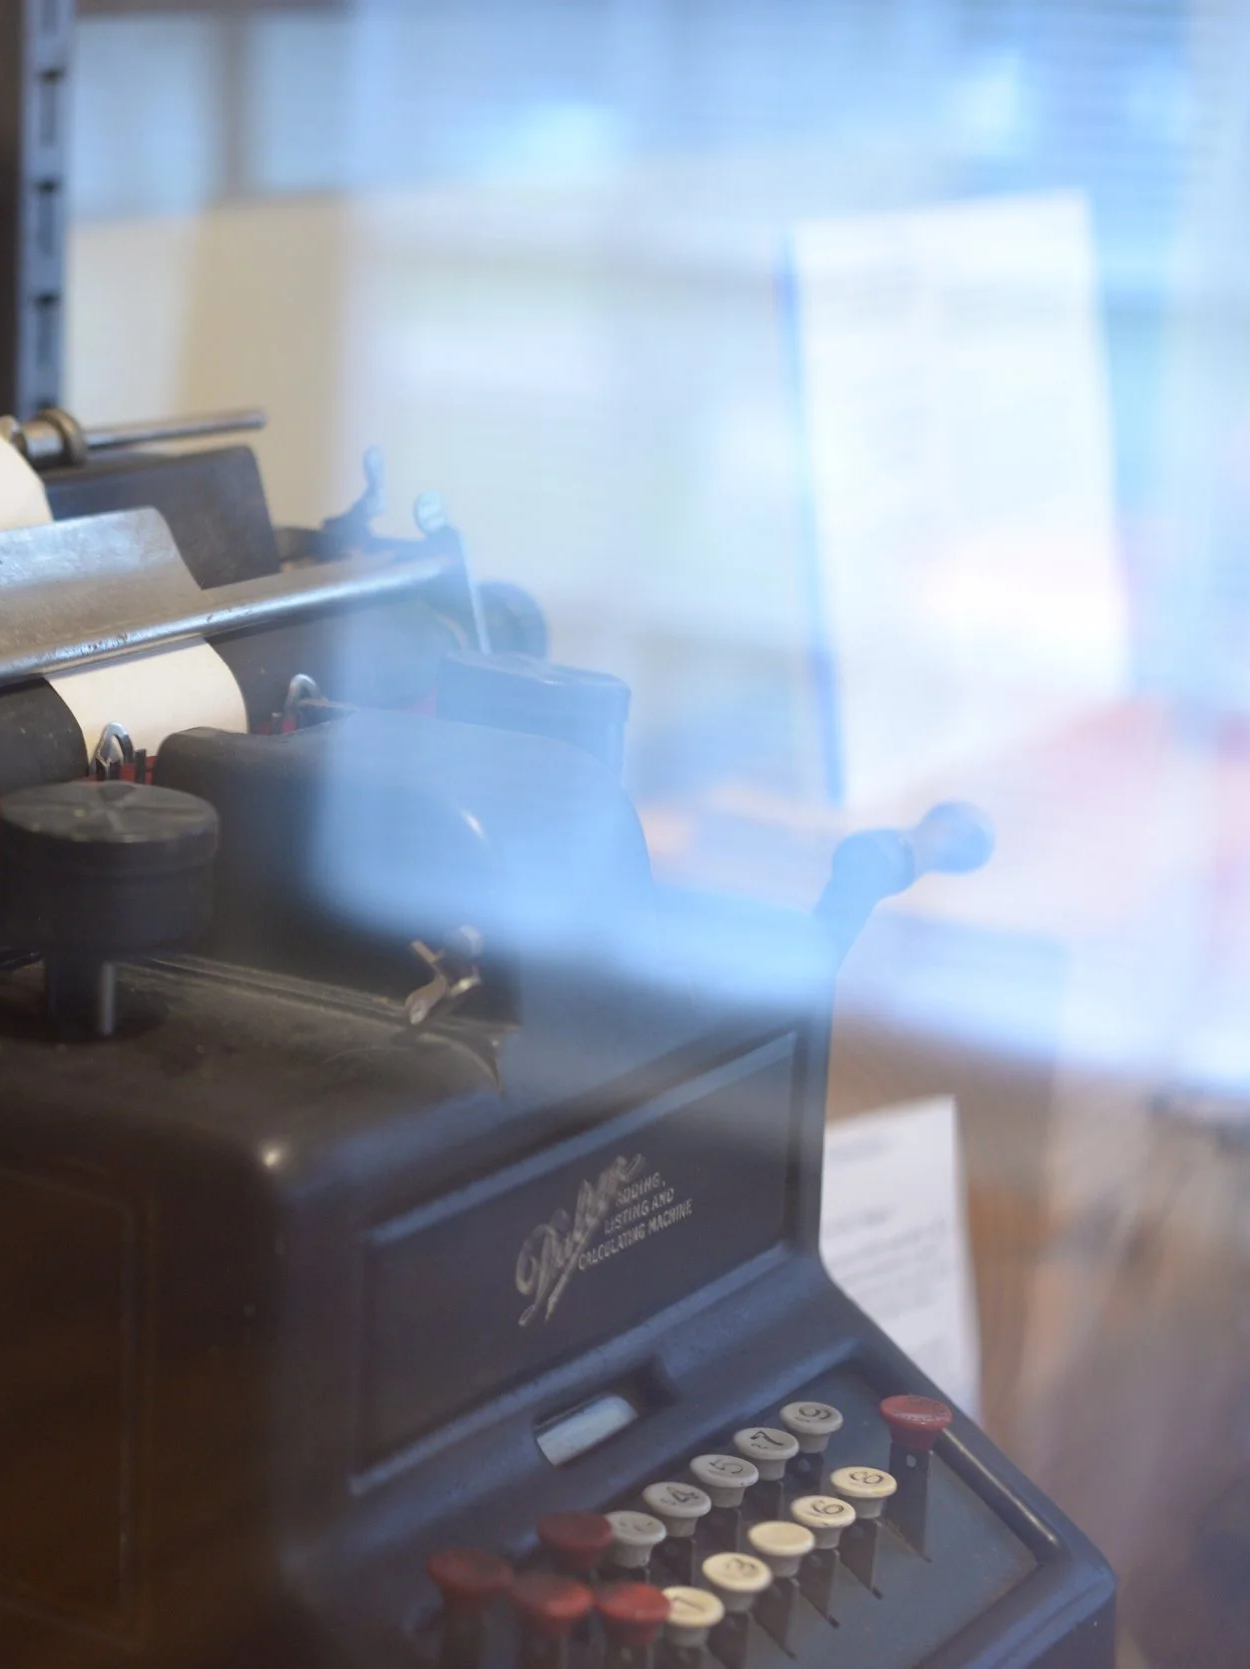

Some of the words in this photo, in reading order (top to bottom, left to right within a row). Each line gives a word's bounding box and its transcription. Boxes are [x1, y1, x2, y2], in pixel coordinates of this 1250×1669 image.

[651, 1188, 674, 1211] AND
[648, 1198, 694, 1235] MACHINE
[798, 1406, 832, 1420] 9
[750, 1430, 785, 1446] 7
[709, 1459, 744, 1474] 5
[849, 1470, 884, 1485] 8
[811, 1500, 845, 1515] 6
